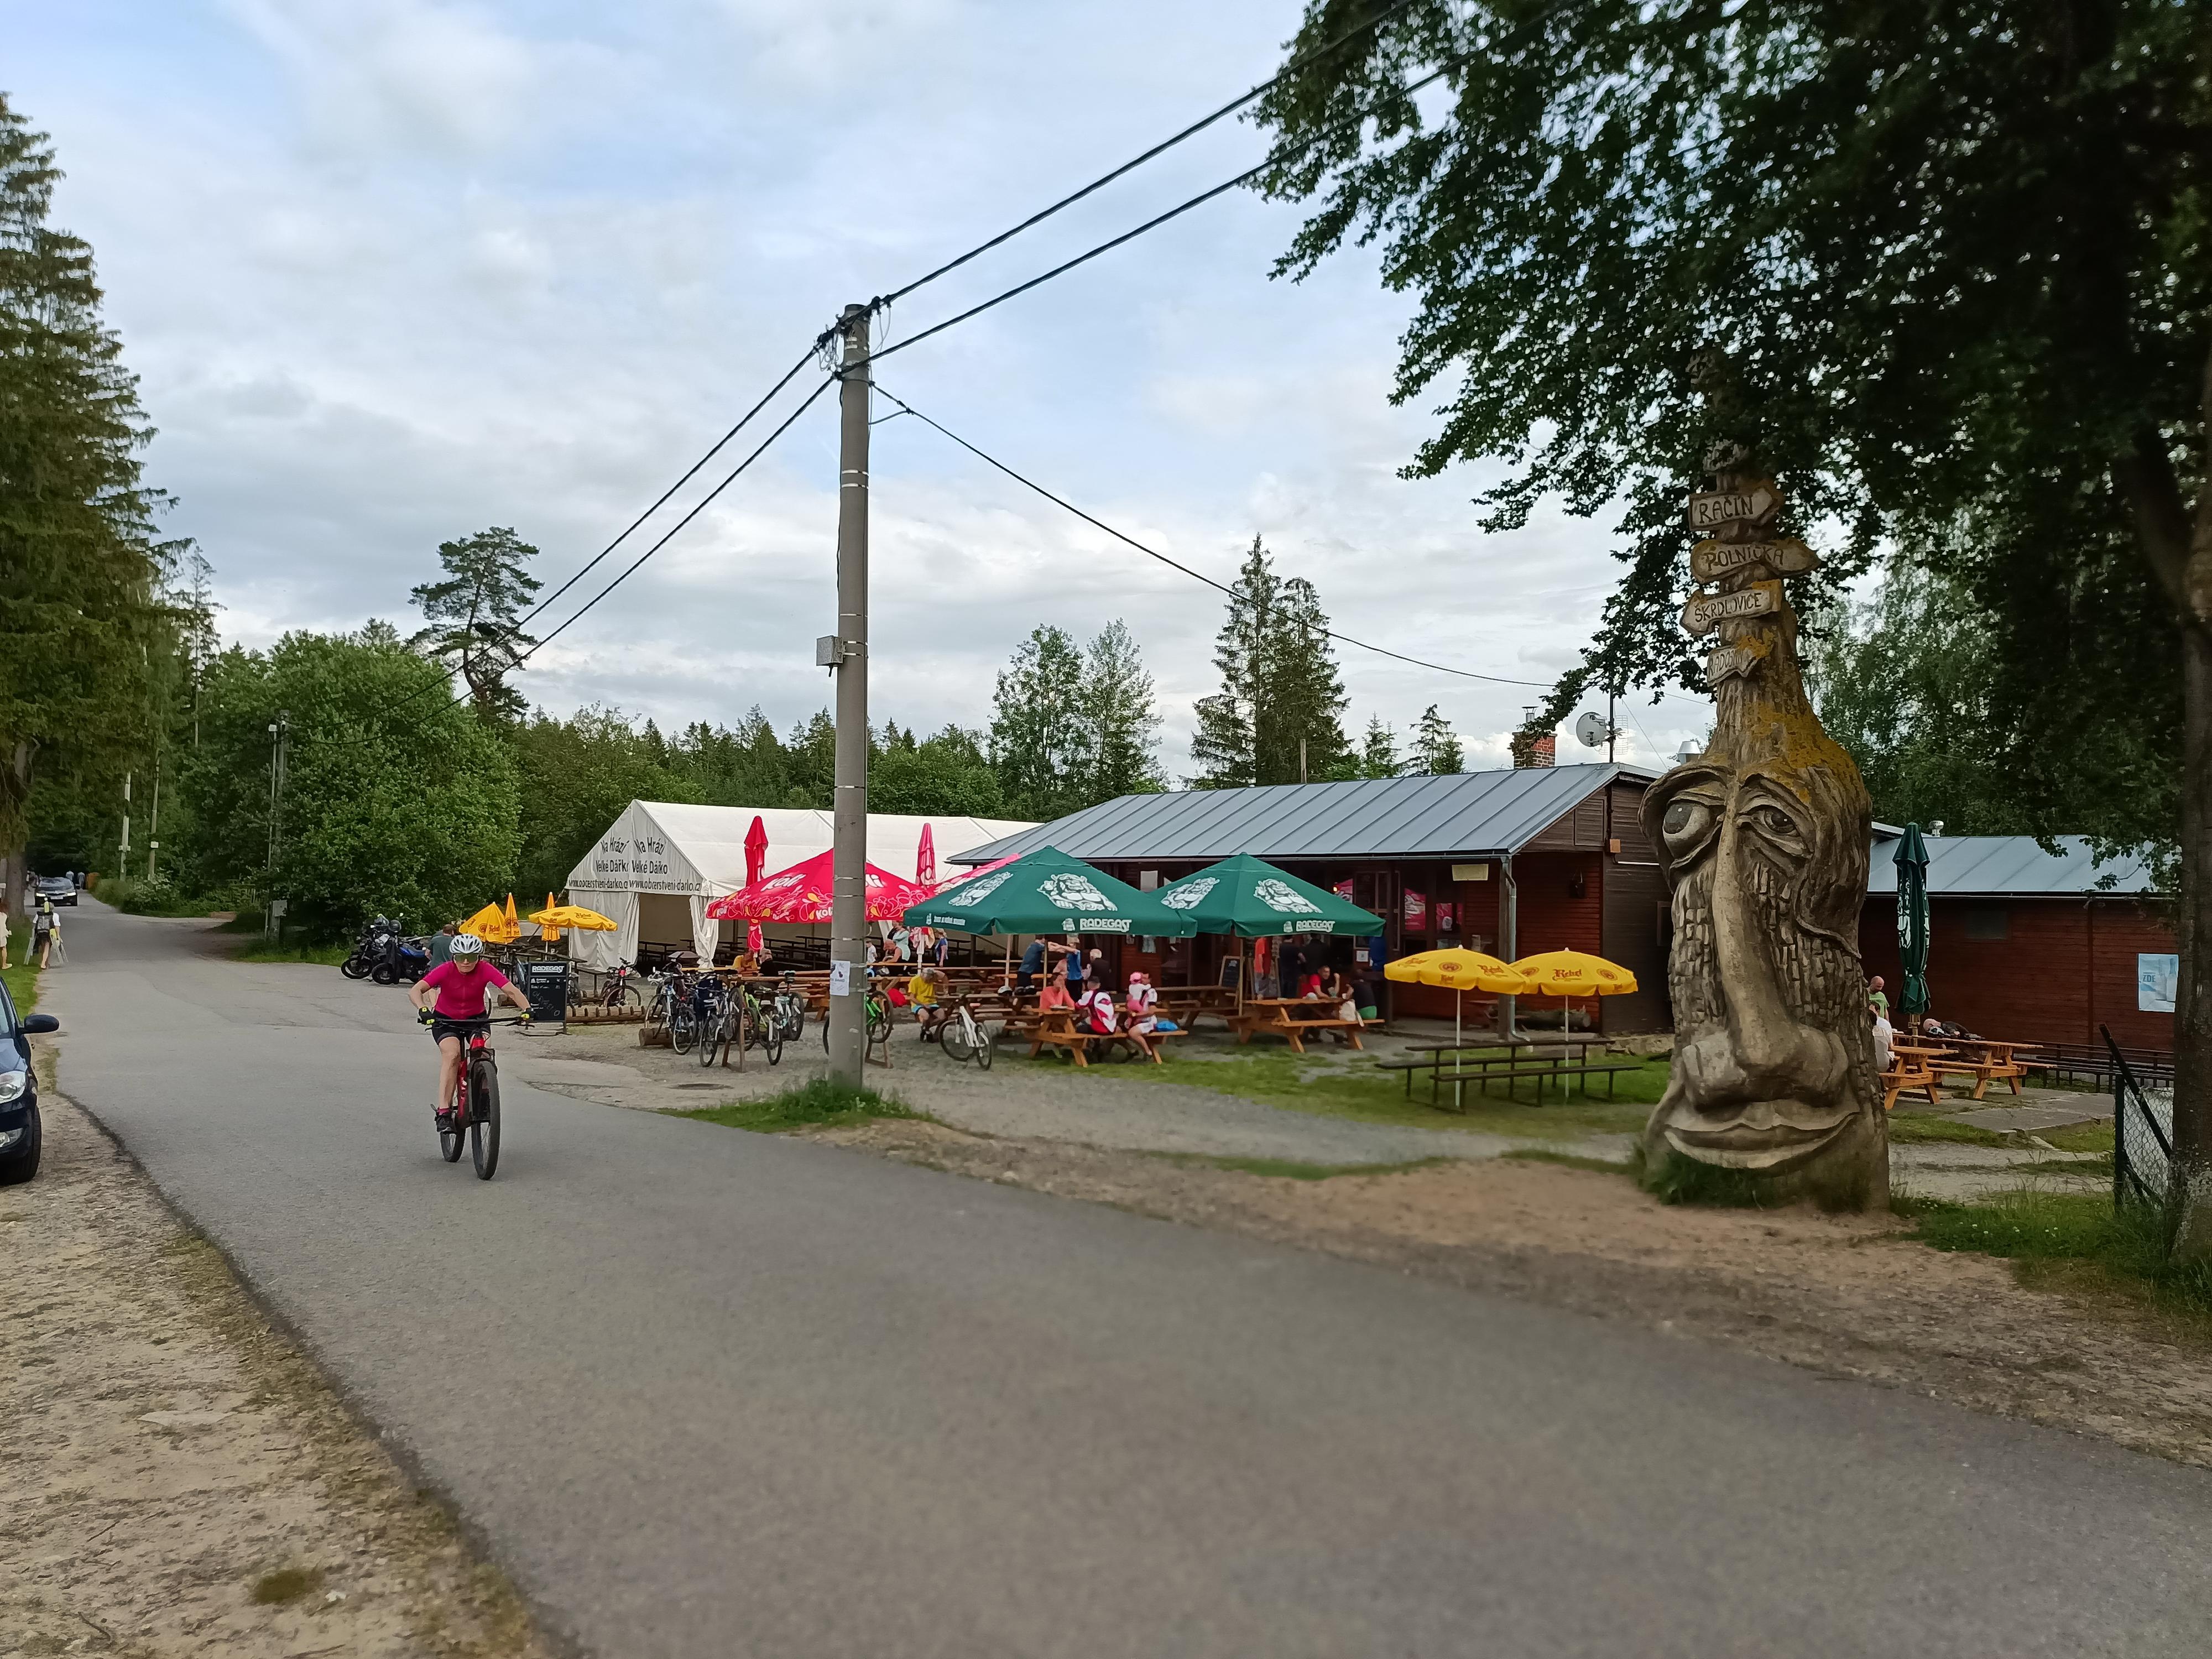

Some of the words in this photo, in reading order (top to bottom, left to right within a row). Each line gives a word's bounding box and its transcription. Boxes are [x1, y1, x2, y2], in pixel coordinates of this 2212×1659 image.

[1699, 496, 1754, 524] RAČÍN
[1694, 592, 1762, 623] ŠKRDLOVICE
[600, 839, 608, 855] Na
[609, 837, 630, 854] Hrází
[633, 838, 646, 855] Na
[632, 859, 648, 873] Velké
[1079, 918, 1132, 932] RADEGAST
[1296, 920, 1335, 932] RADEGAST
